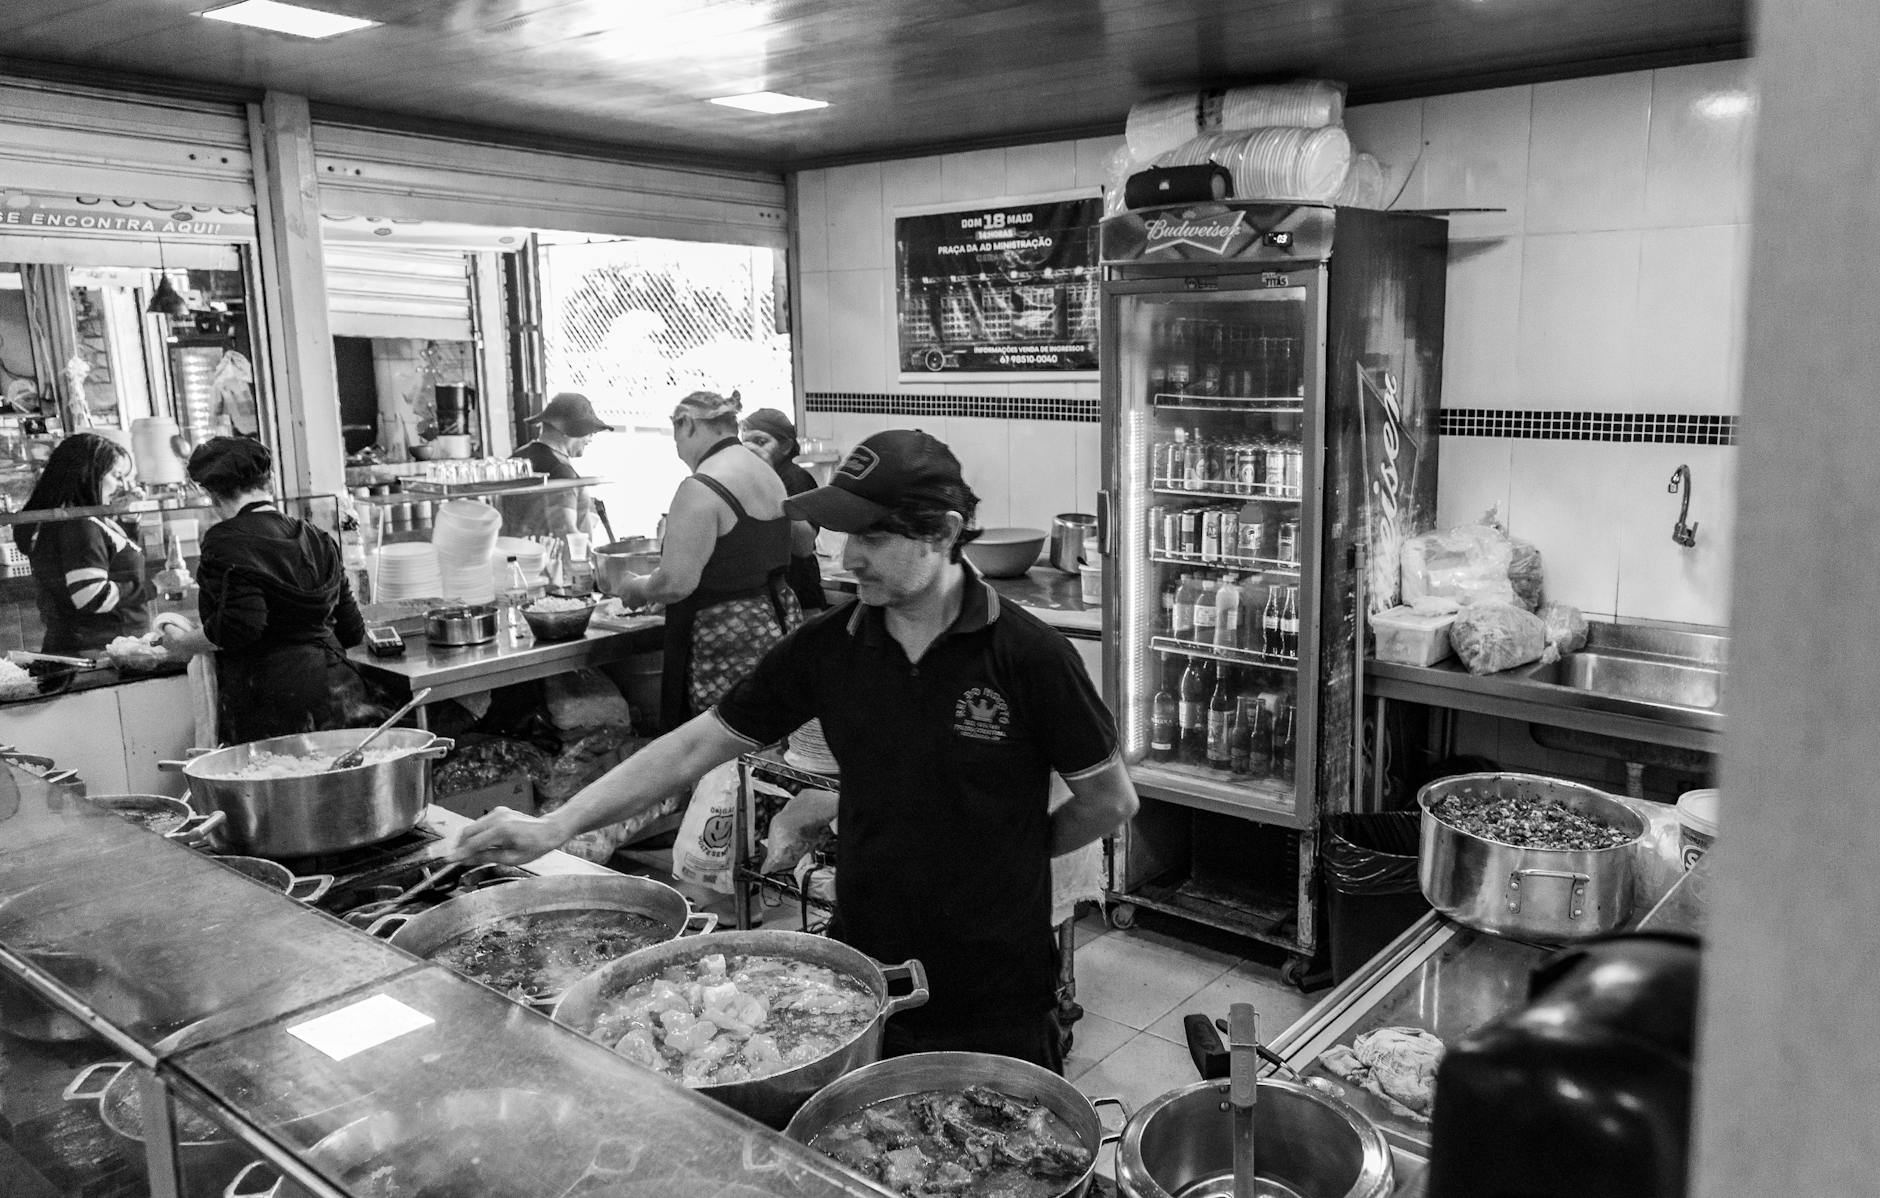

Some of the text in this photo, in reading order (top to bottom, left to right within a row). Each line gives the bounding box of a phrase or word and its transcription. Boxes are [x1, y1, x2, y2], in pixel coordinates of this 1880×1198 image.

[31, 212, 155, 232] ENCONTRA
[961, 213, 1033, 230] DOM 18 MAIO
[1145, 218, 1241, 240] Budweiser
[938, 244, 965, 256] PRAÇA
[966, 243, 978, 253] DA
[1018, 345, 1039, 353] VENDA
[1040, 345, 1049, 353] DE
[1049, 344, 1085, 352] INGRESSOS
